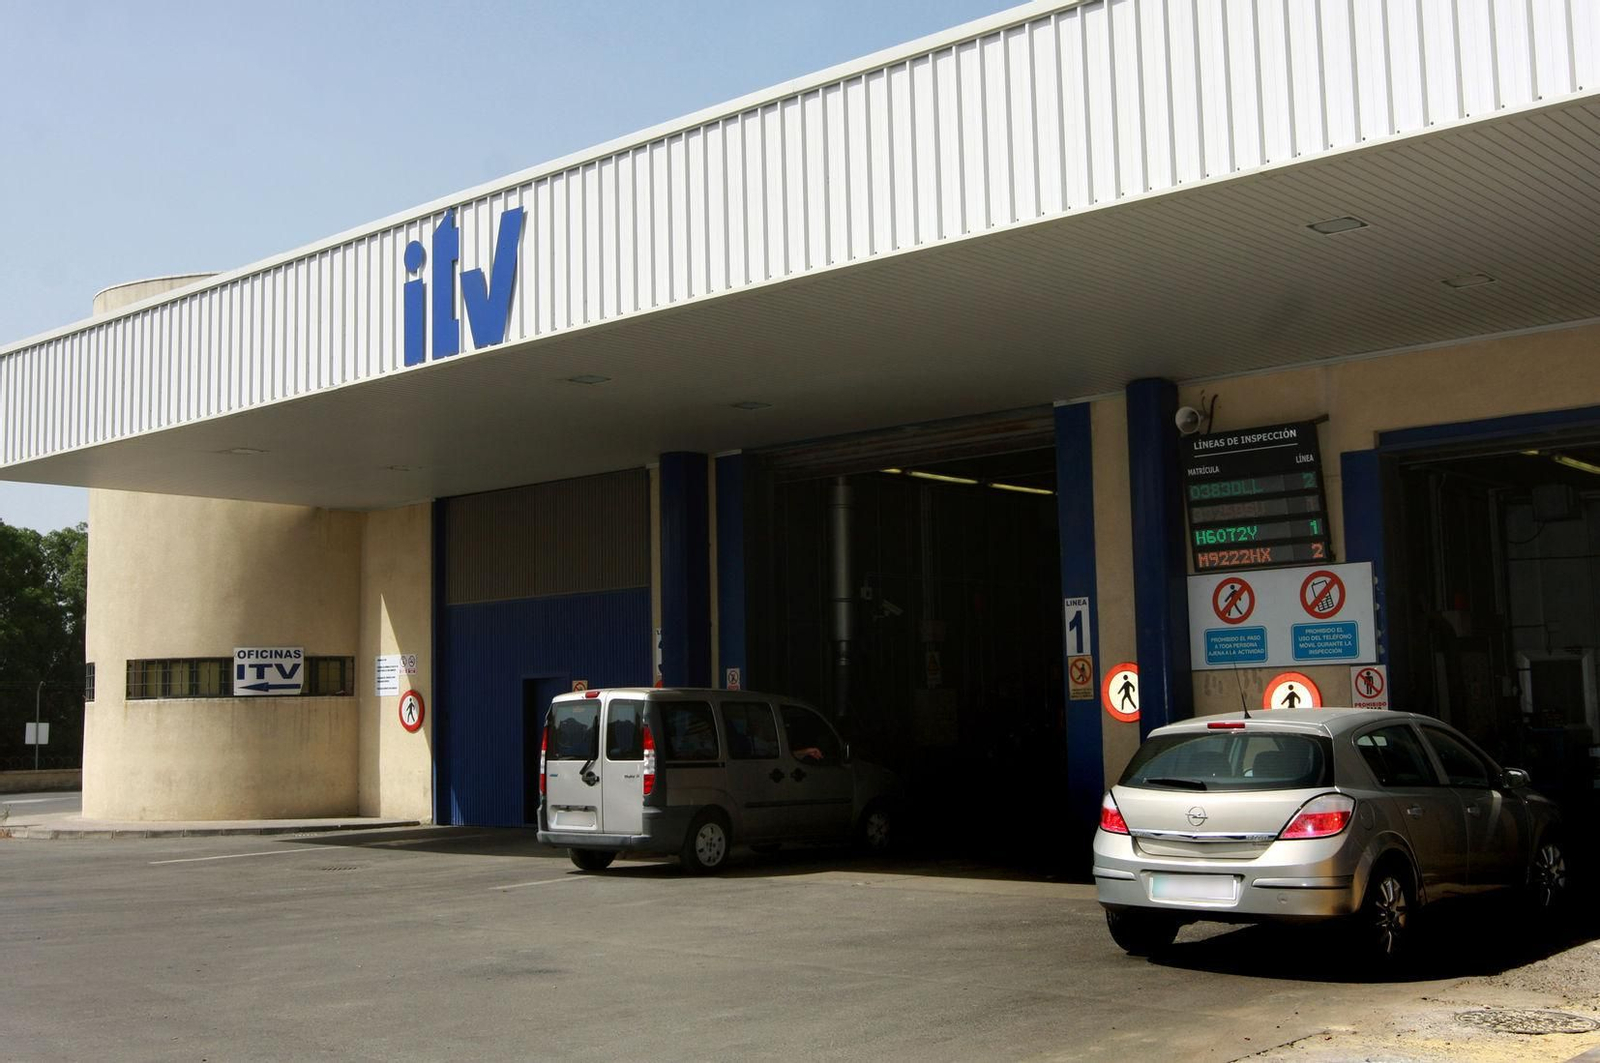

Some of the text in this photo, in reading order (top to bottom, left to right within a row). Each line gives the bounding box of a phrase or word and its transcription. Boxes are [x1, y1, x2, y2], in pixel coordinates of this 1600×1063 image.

[404, 208, 524, 367] itv
[1193, 427, 1298, 450] LÍNEAS DE INSPECCIÓN
[1295, 452, 1315, 464] LÍNEA
[1187, 465, 1220, 476] MATRÍCULA
[1302, 471, 1316, 488] 2
[1310, 519, 1319, 535] 1
[1311, 542, 1324, 559] 2
[1065, 599, 1087, 607] LINEA
[1069, 610, 1084, 654] 1
[237, 650, 301, 660] OFICINAS
[236, 663, 301, 680] ITV
